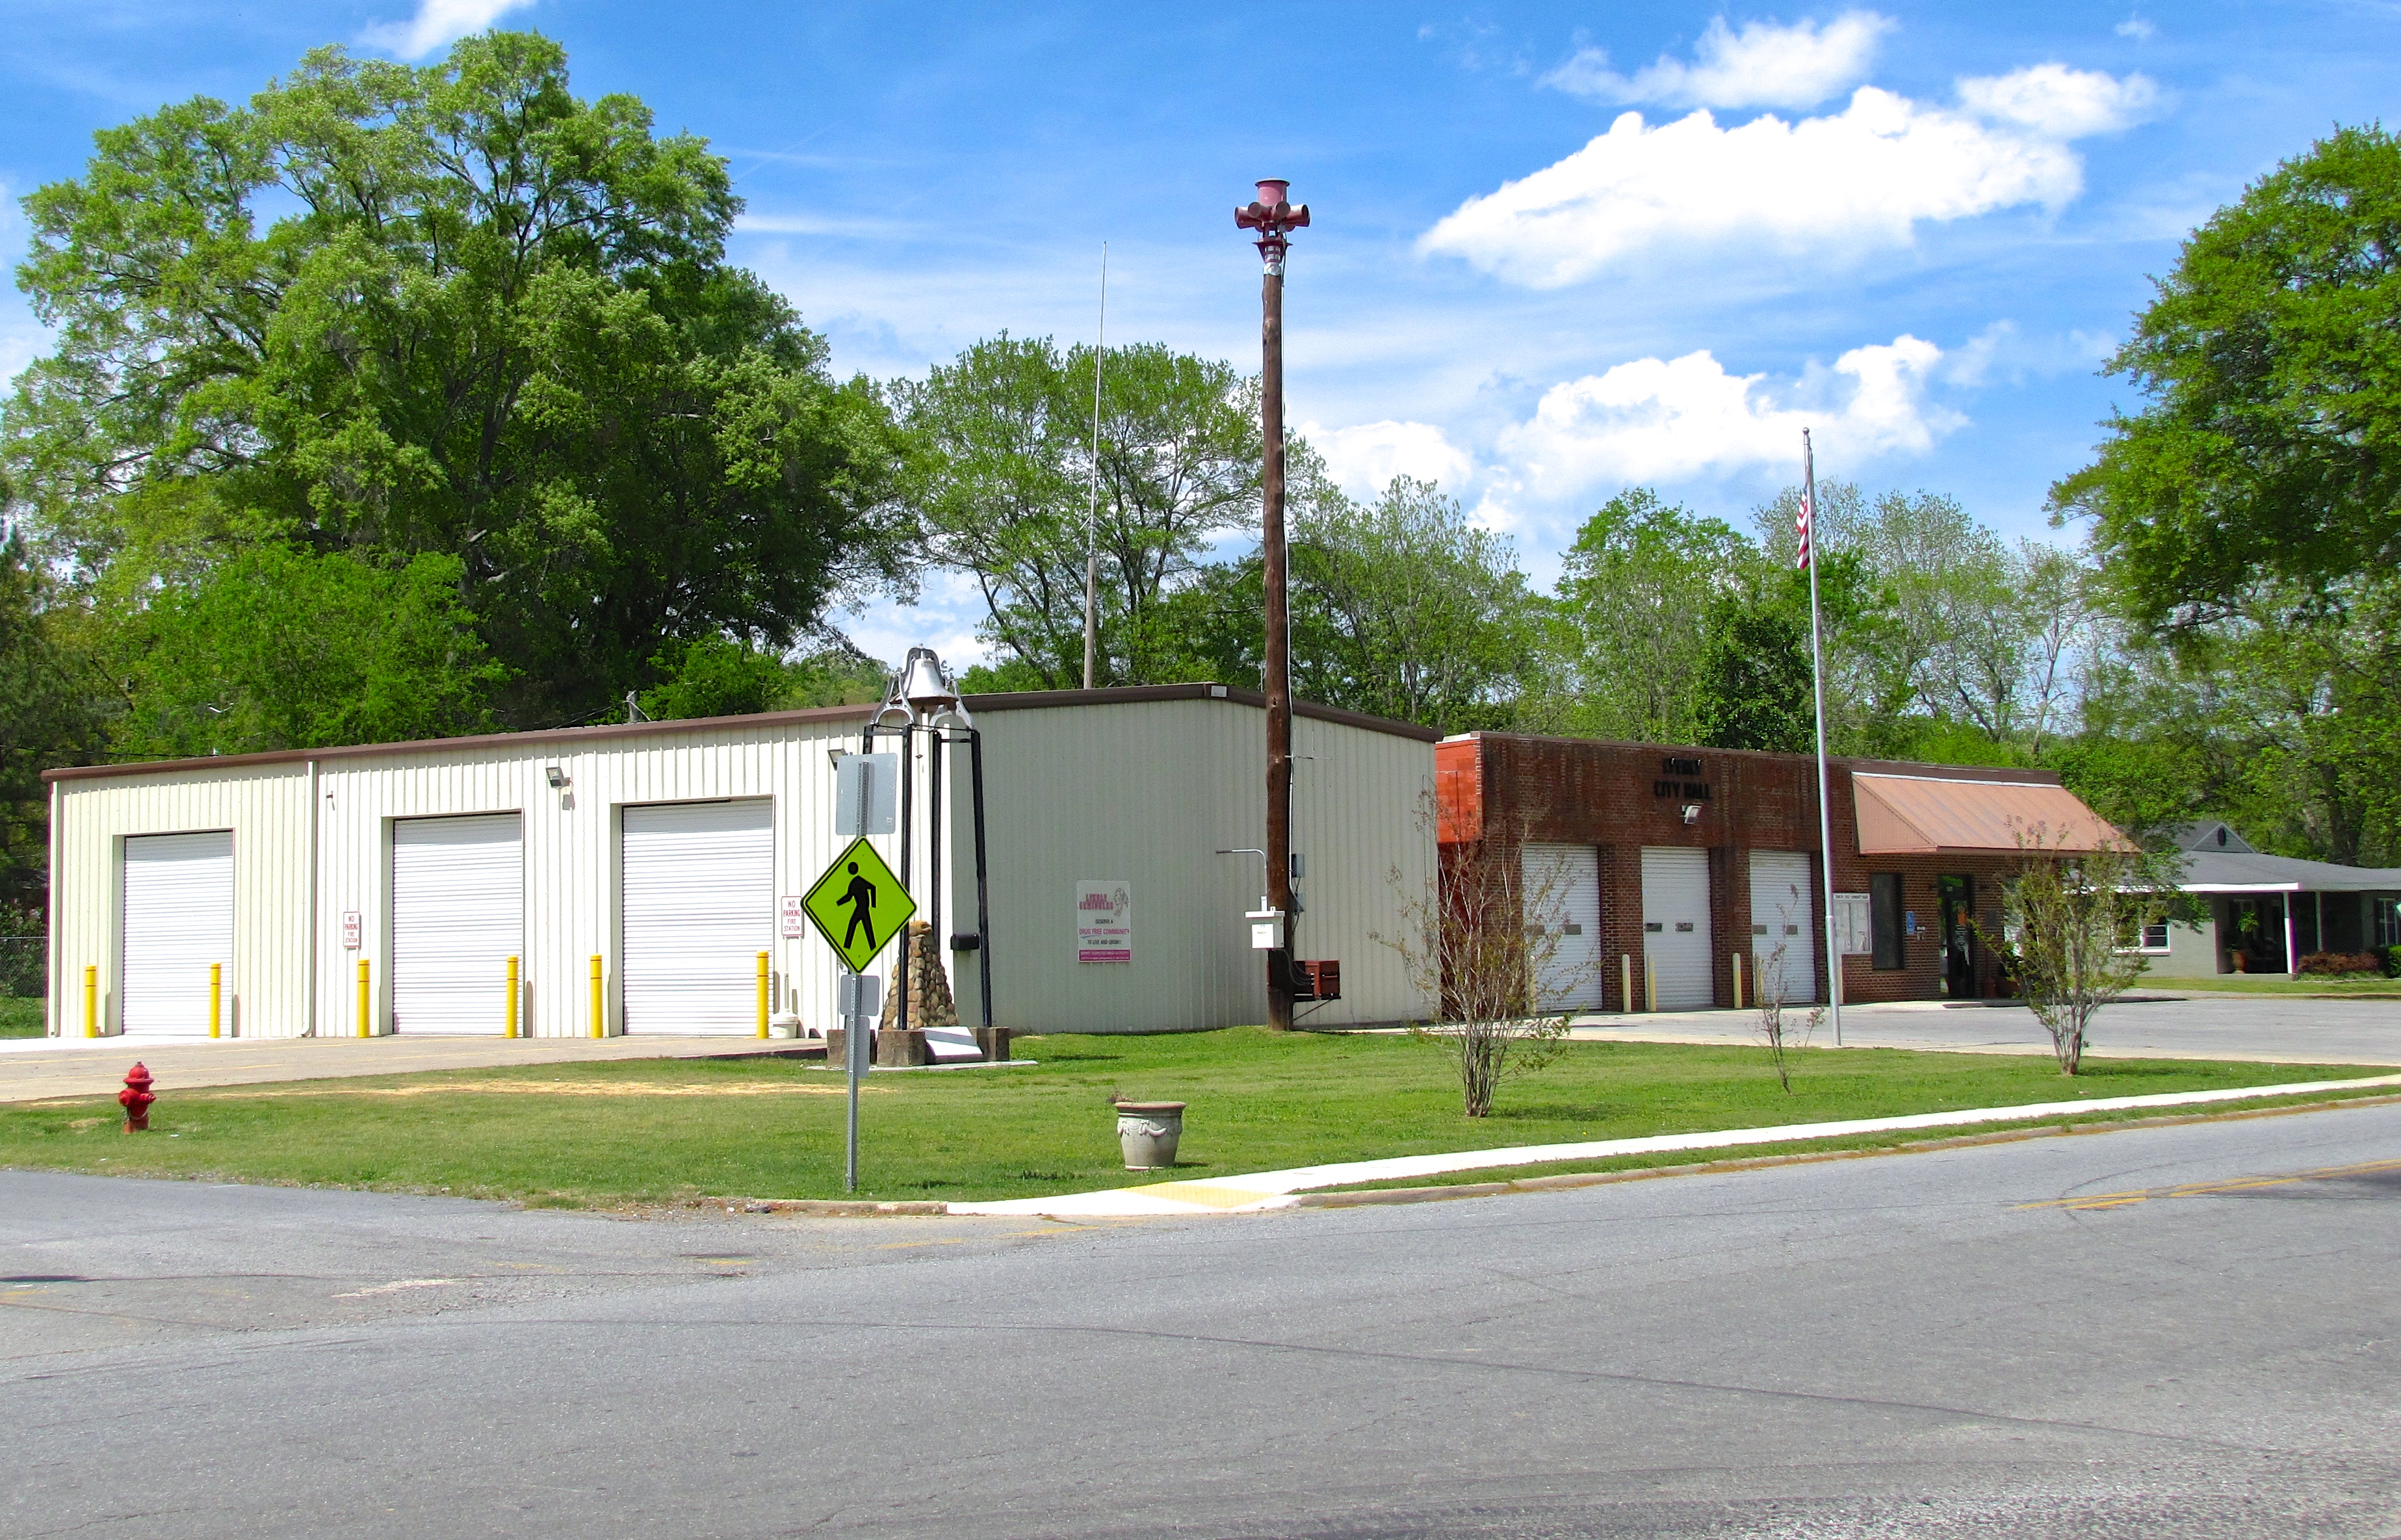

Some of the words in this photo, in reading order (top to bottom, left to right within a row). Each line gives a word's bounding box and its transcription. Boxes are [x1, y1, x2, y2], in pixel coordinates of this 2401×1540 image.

[1654, 781, 1681, 798] CITY
[1684, 782, 1713, 799] HALL
[788, 900, 796, 908] NO
[783, 909, 800, 918] PARKING
